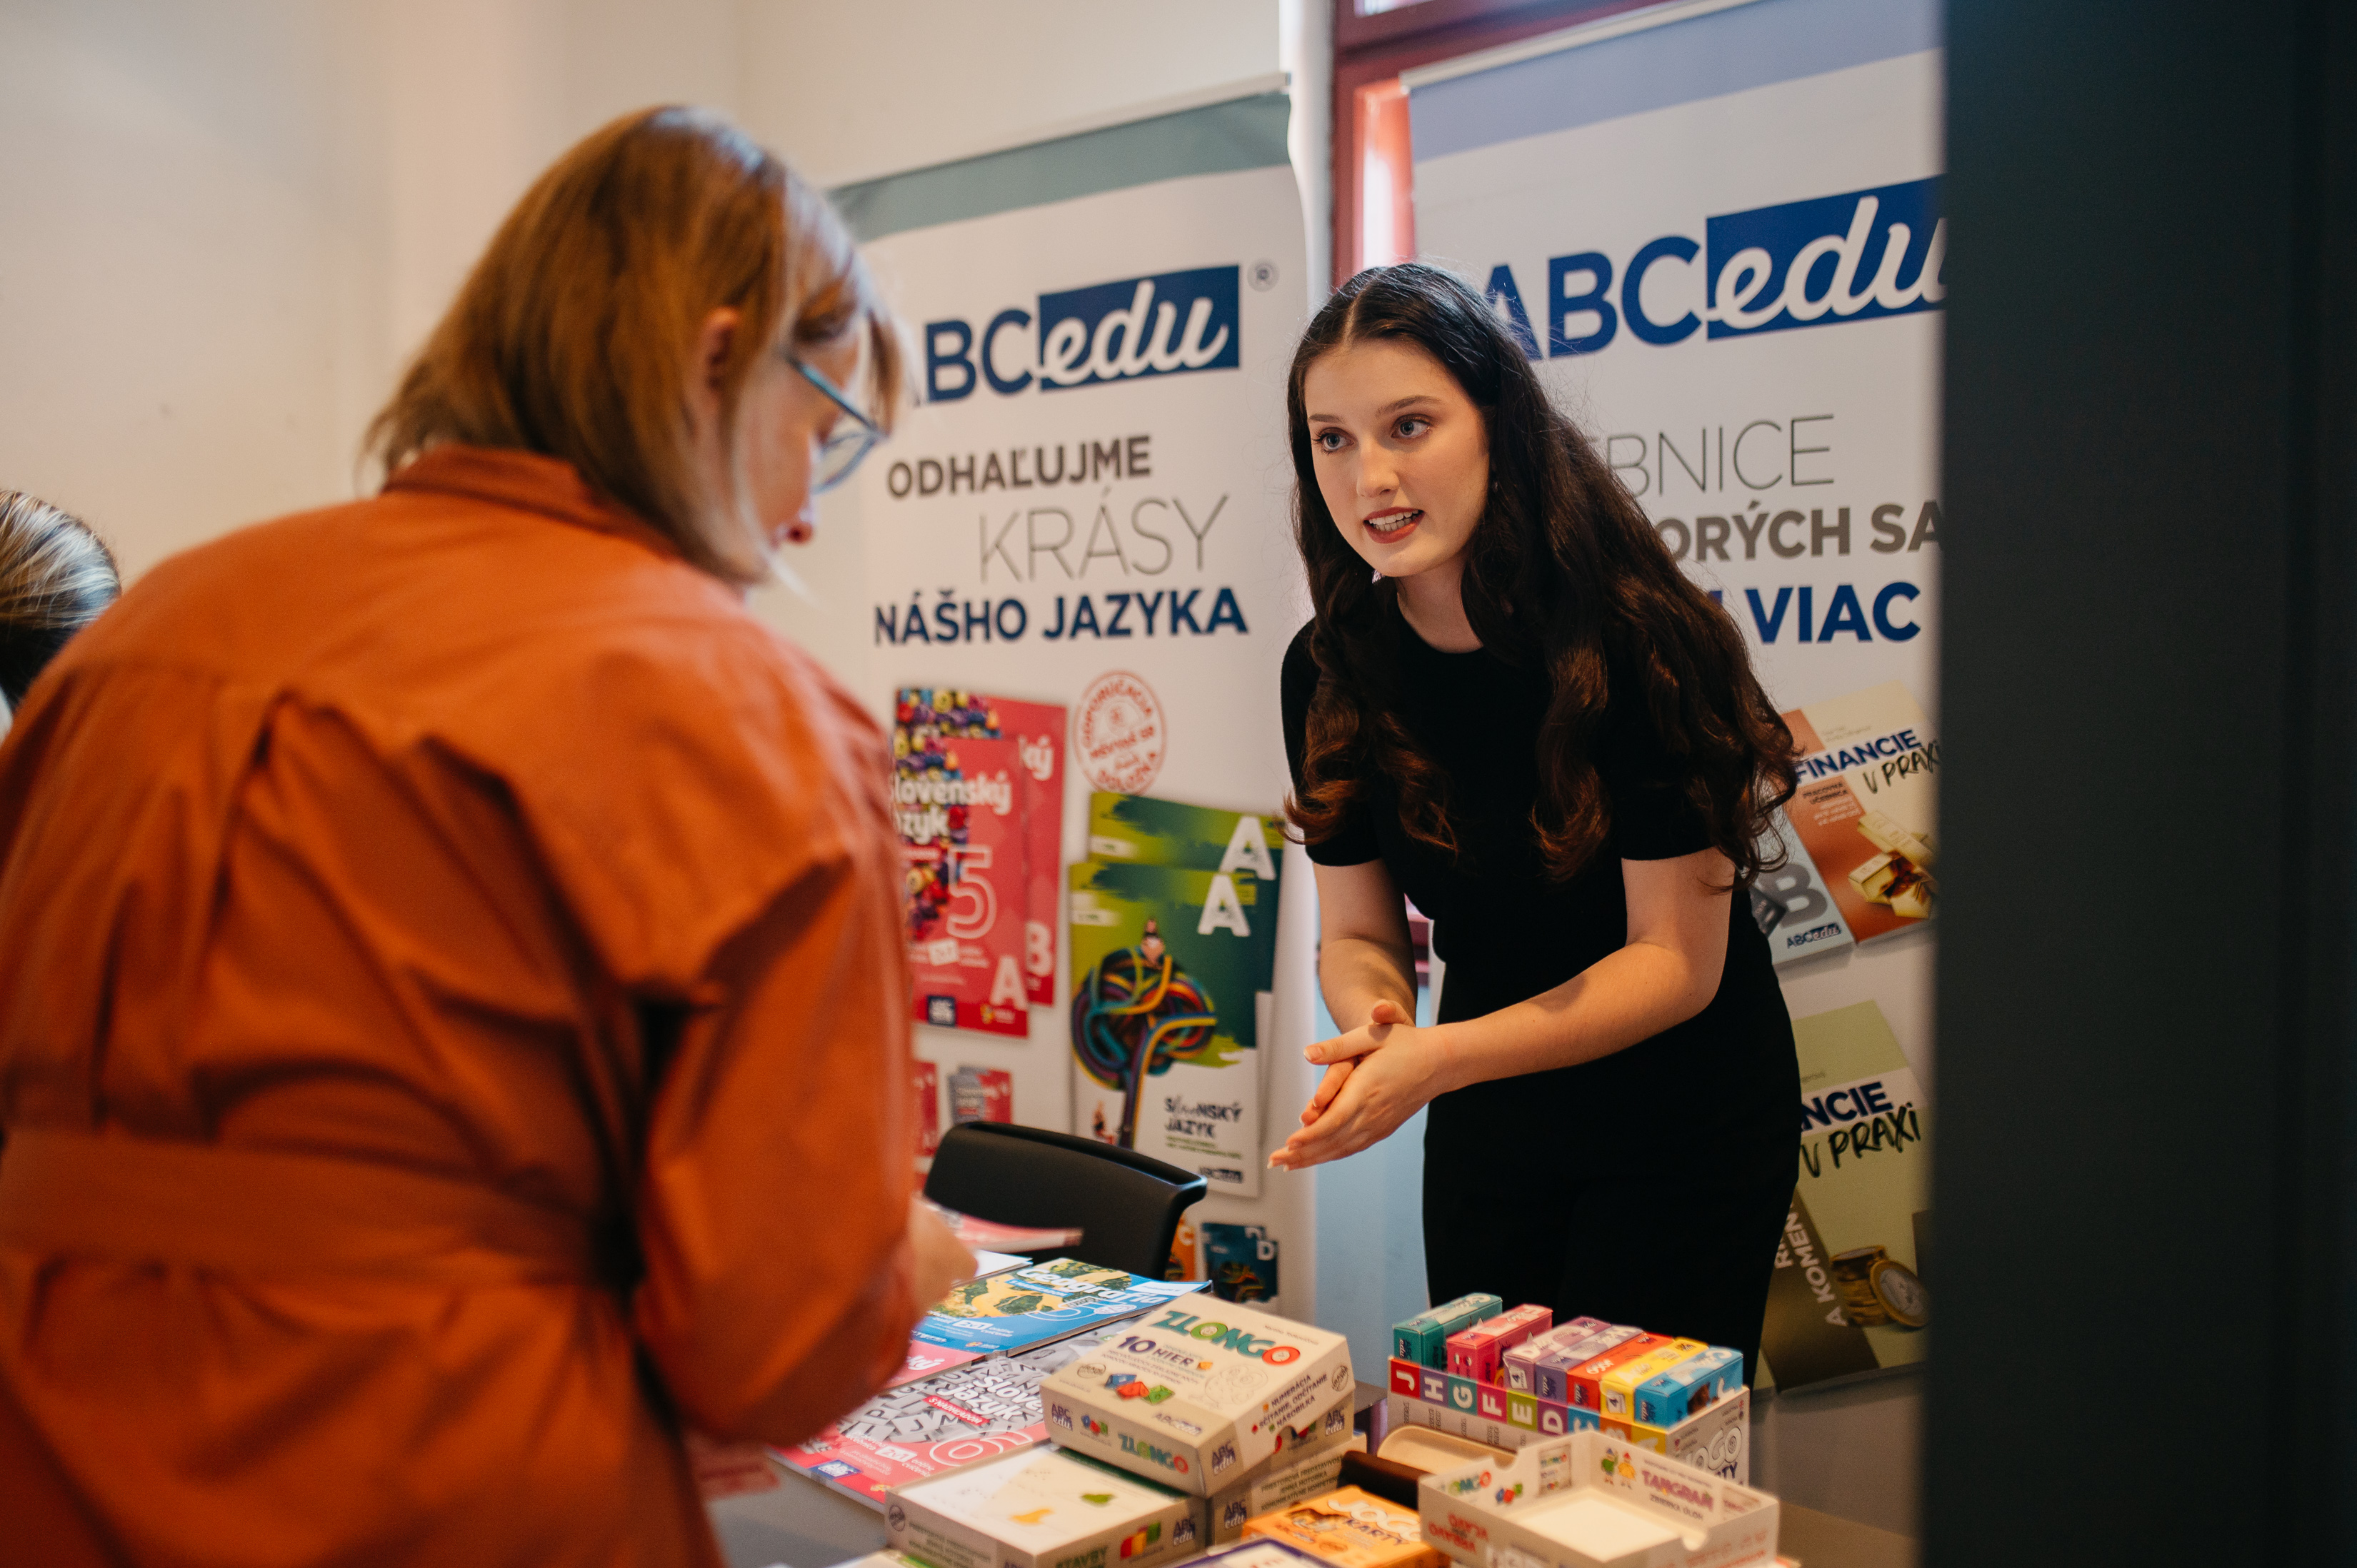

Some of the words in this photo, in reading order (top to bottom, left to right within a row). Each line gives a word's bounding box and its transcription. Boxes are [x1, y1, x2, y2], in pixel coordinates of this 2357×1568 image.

[914, 278, 1232, 407] BCedu
[886, 435, 1153, 499] ODHAĽUJME
[979, 486, 1229, 584] KRÁSY
[874, 589, 1027, 647] NÁŠHO
[1042, 588, 1250, 640] JAZYKA
[1743, 581, 1921, 644] VIAC
[1218, 815, 1276, 880] A
[946, 845, 997, 939] 5
[1197, 874, 1251, 937] A
[1026, 921, 1053, 977] B
[1786, 923, 1841, 948] ABCedu
[990, 955, 1028, 1011] A
[1256, 1240, 1275, 1261] D
[1016, 1268, 1170, 1305] Geografia
[1825, 1307, 1848, 1327] A
[1117, 1335, 1157, 1354] 10
[1152, 1348, 1195, 1367] HIER
[1149, 1310, 1301, 1367] ZLONGO
[1271, 1374, 1311, 1407] NUMERÁCIA
[1396, 1370, 1415, 1392] J
[1423, 1377, 1443, 1402] H
[1453, 1385, 1473, 1409] G
[936, 1383, 1024, 1421] jazyk
[1051, 1403, 1072, 1420] ABC
[1482, 1393, 1503, 1417] F
[1512, 1402, 1533, 1426] E
[1053, 1415, 1073, 1431] edu
[1543, 1409, 1563, 1434] D
[1118, 1432, 1189, 1475] ZLONGO
[1642, 1469, 1714, 1512] TANGRAM
[1223, 1499, 1247, 1522] ABC
[1225, 1513, 1247, 1530] edu
